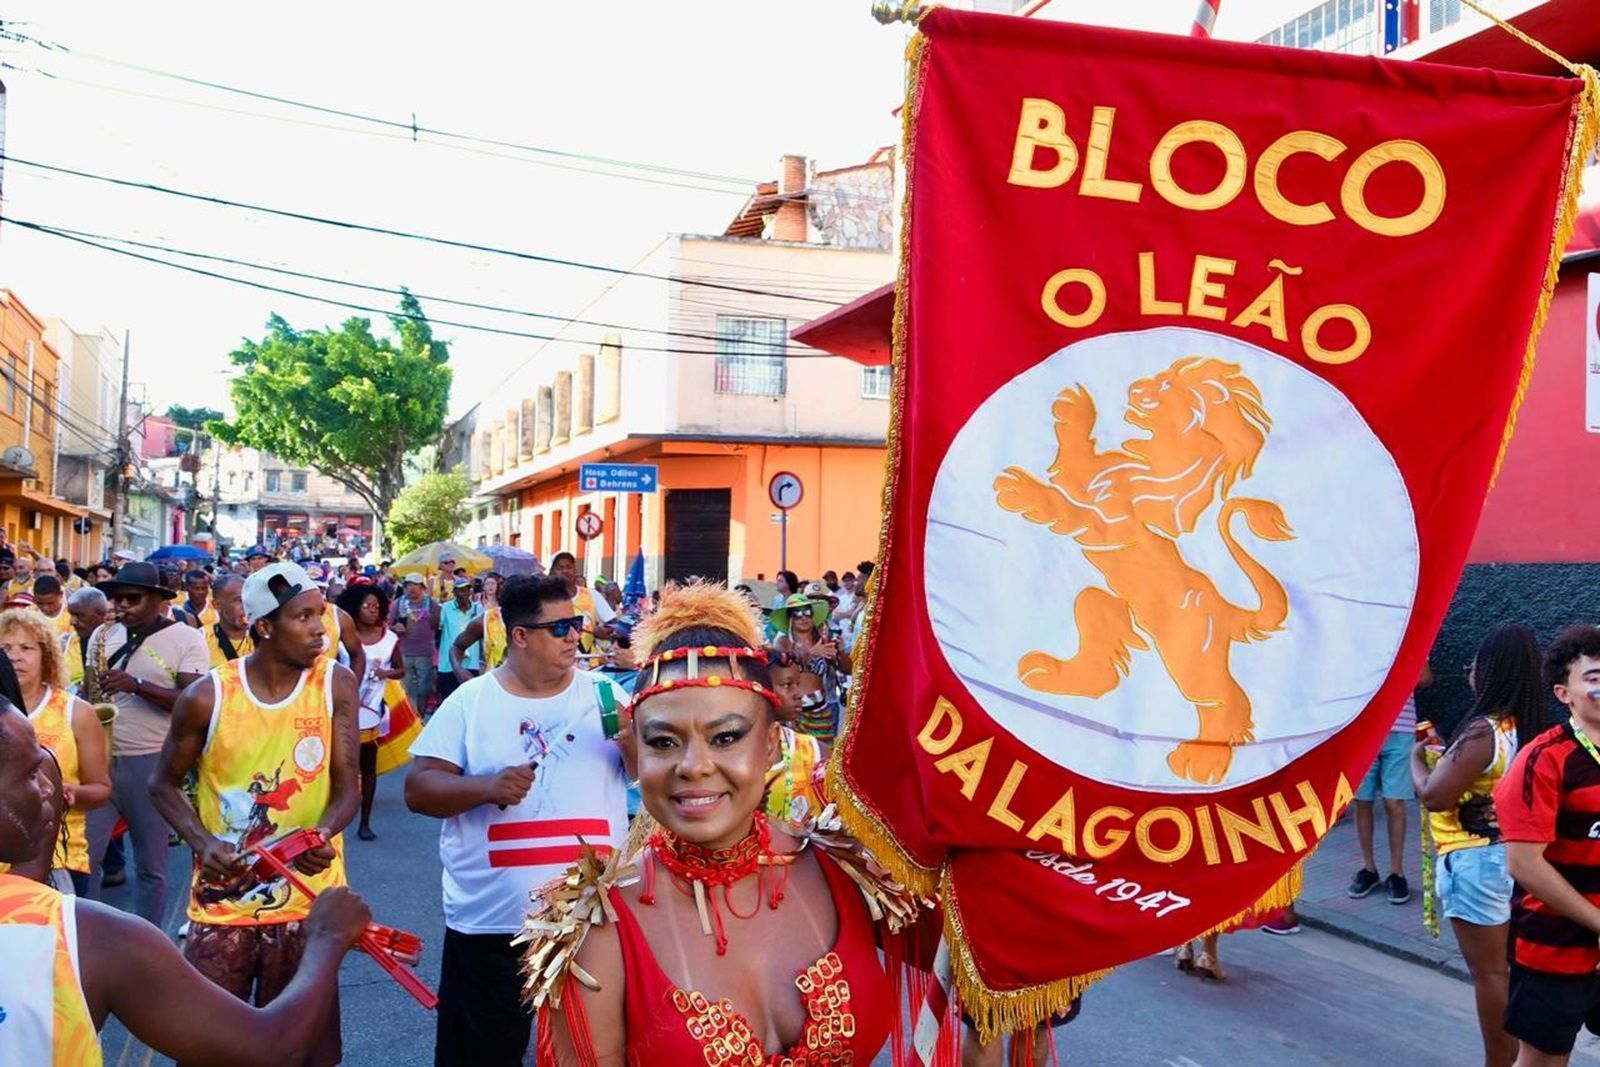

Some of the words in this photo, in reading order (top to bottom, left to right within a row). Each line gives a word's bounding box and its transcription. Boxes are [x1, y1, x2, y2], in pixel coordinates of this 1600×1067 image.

[1006, 97, 1447, 237] BLOCO
[1041, 268, 1107, 328] O
[1138, 251, 1372, 364] LEÃO
[584, 468, 608, 478] Hosp.
[610, 469, 638, 477] Odilon
[600, 480, 638, 488] Behrens
[917, 694, 995, 801] DA
[986, 759, 1355, 866] LAGOINHA
[1025, 849, 1098, 885] esde
[1095, 877, 1191, 918] 1947
